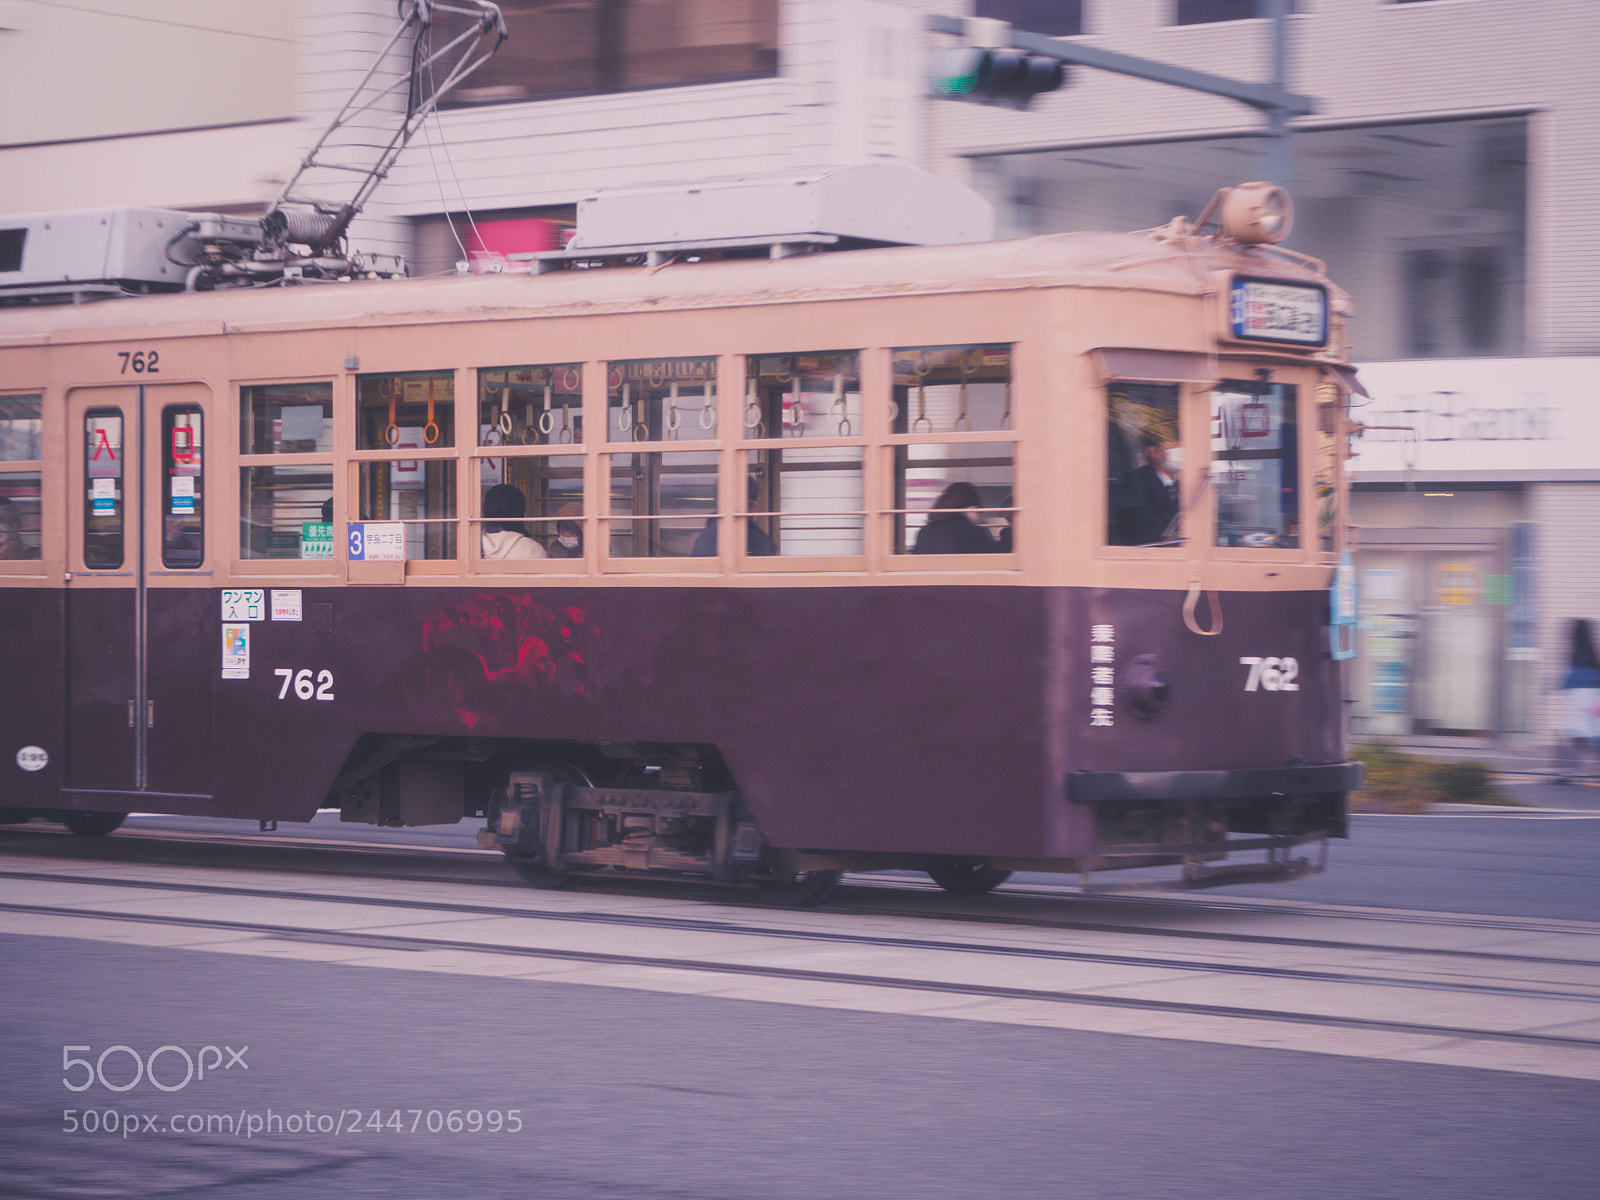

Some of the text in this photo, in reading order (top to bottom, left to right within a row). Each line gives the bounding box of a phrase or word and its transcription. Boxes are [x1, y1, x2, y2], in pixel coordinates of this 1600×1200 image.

[117, 350, 160, 375] 762
[92, 429, 115, 461] 入
[172, 427, 194, 459] 口
[350, 530, 363, 555] 3
[224, 591, 263, 604] ワンマン
[225, 657, 247, 666] PASPY
[1239, 656, 1300, 692] 762
[274, 668, 335, 701] 762
